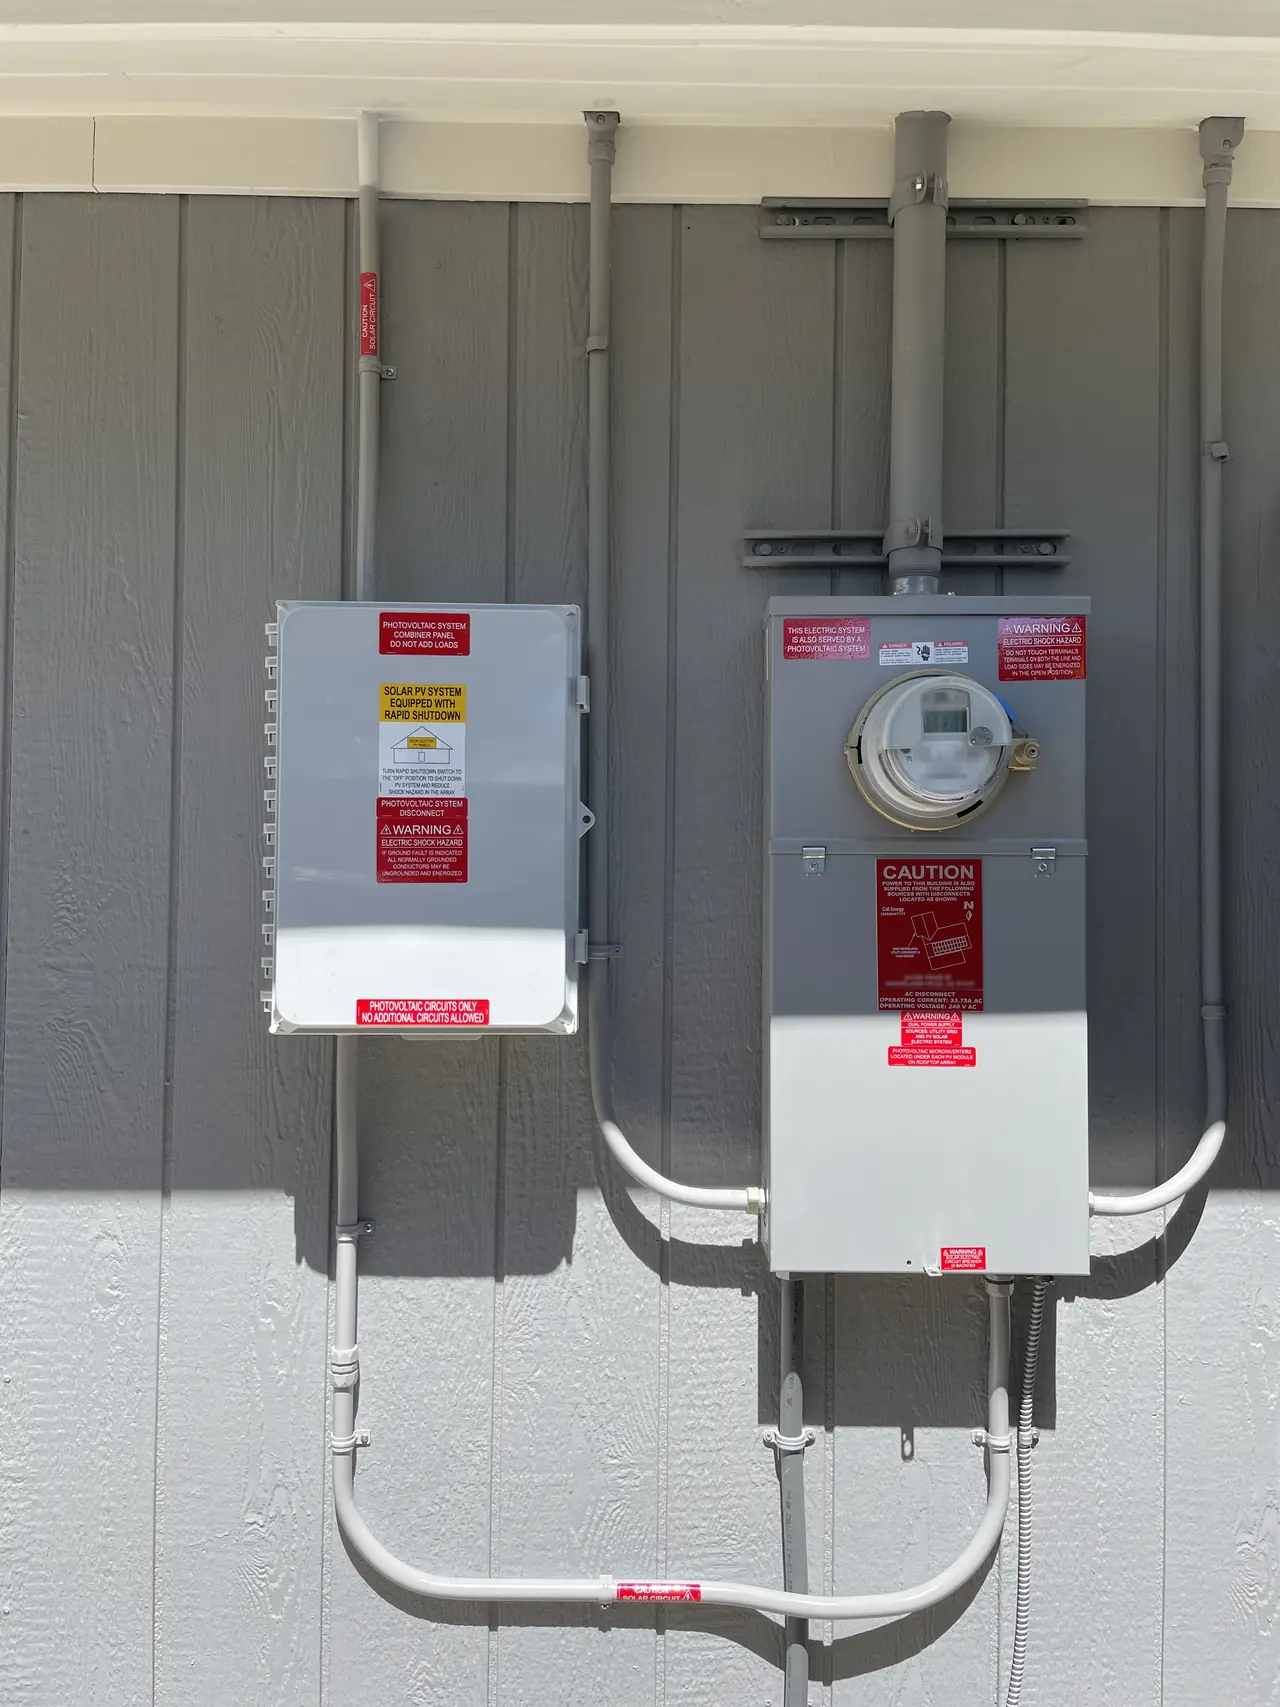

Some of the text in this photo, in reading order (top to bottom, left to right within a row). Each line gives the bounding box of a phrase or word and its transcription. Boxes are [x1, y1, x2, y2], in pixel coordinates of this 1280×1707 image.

[383, 621, 436, 629] PHOTOVOLTAIC
[1013, 624, 1070, 633] WARNING
[384, 687, 461, 696] SOLAR PV SYSTEM
[390, 699, 455, 708] EQUIPPED WITH
[384, 710, 460, 720] RAPID SHUTDOWN
[393, 825, 451, 835] WARNING
[883, 865, 973, 880] CAUTION
[964, 901, 974, 909] N
[370, 1001, 422, 1011] PHOTOVOLTAIC
[424, 1001, 456, 1011] CIRCUITS
[459, 1001, 477, 1011] ONLY
[362, 1013, 484, 1023] NO ADDITIONAL CIRCUITS ALLOWED
[634, 1585, 669, 1593] CAUTION
